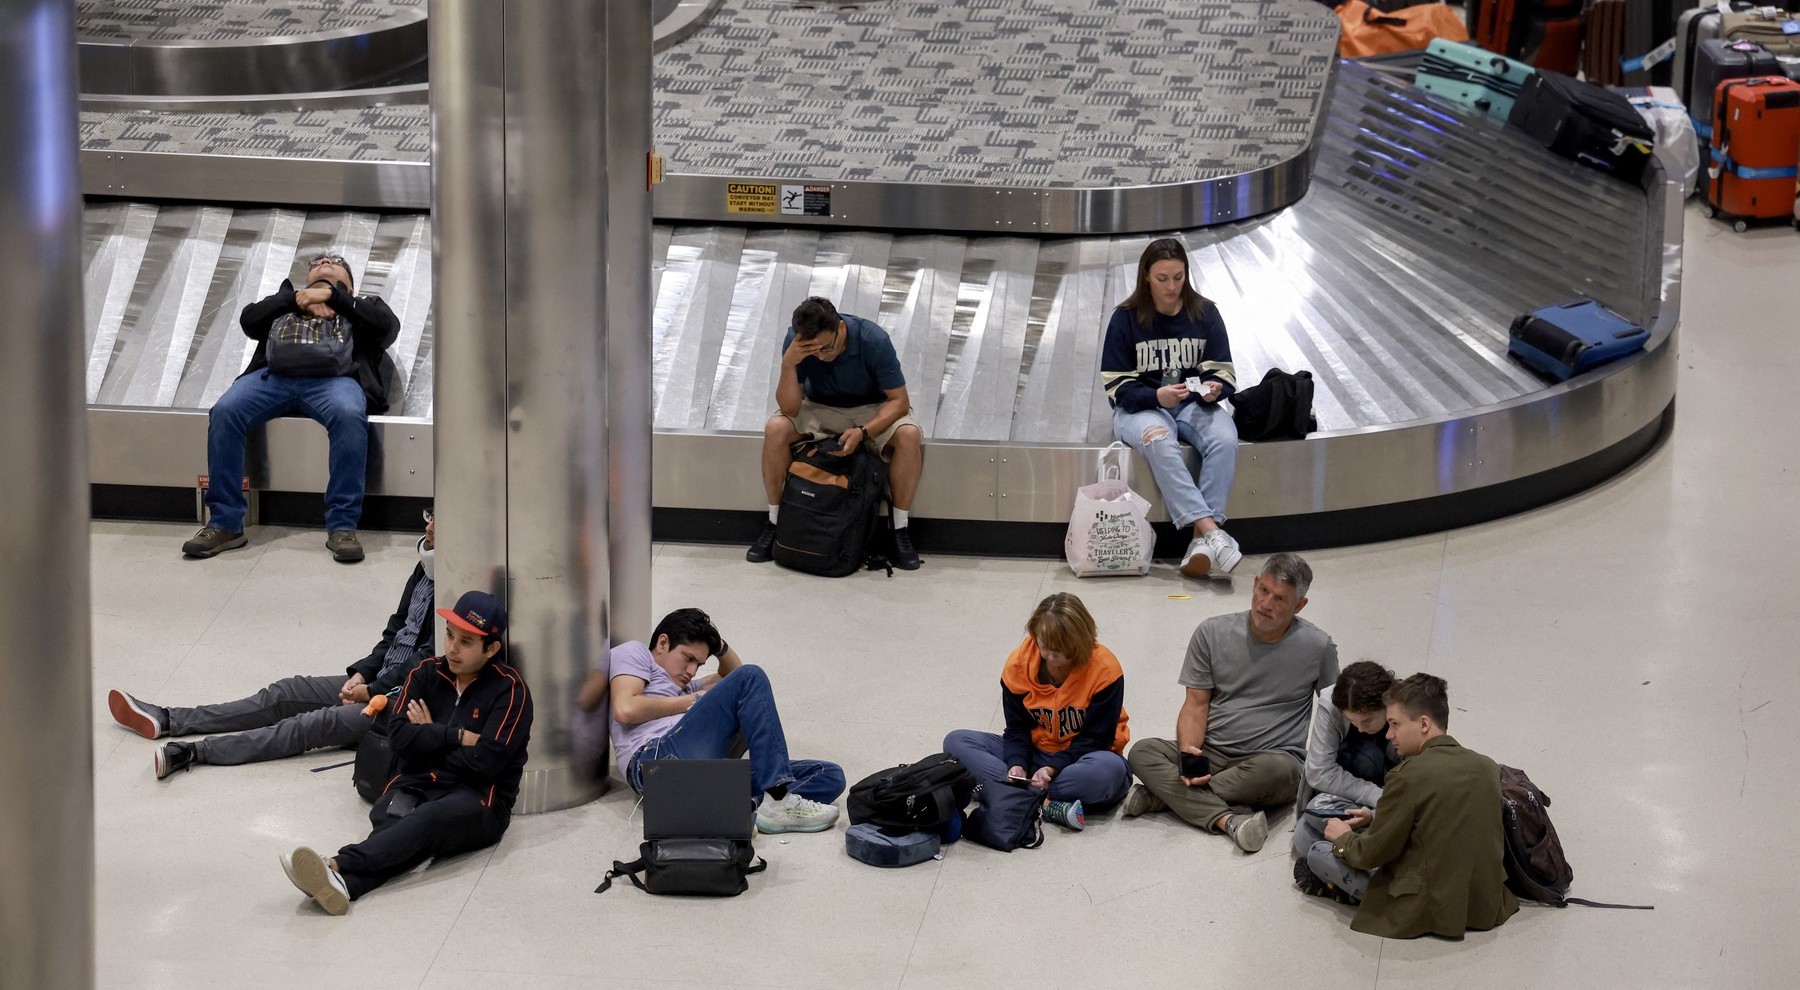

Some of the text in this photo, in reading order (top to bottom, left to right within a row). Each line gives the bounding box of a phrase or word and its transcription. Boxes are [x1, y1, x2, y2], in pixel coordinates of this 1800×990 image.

[730, 184, 775, 194] CAUTION!
[1122, 525, 1131, 533] TO
[1094, 547, 1134, 556] TRAVELER'S
